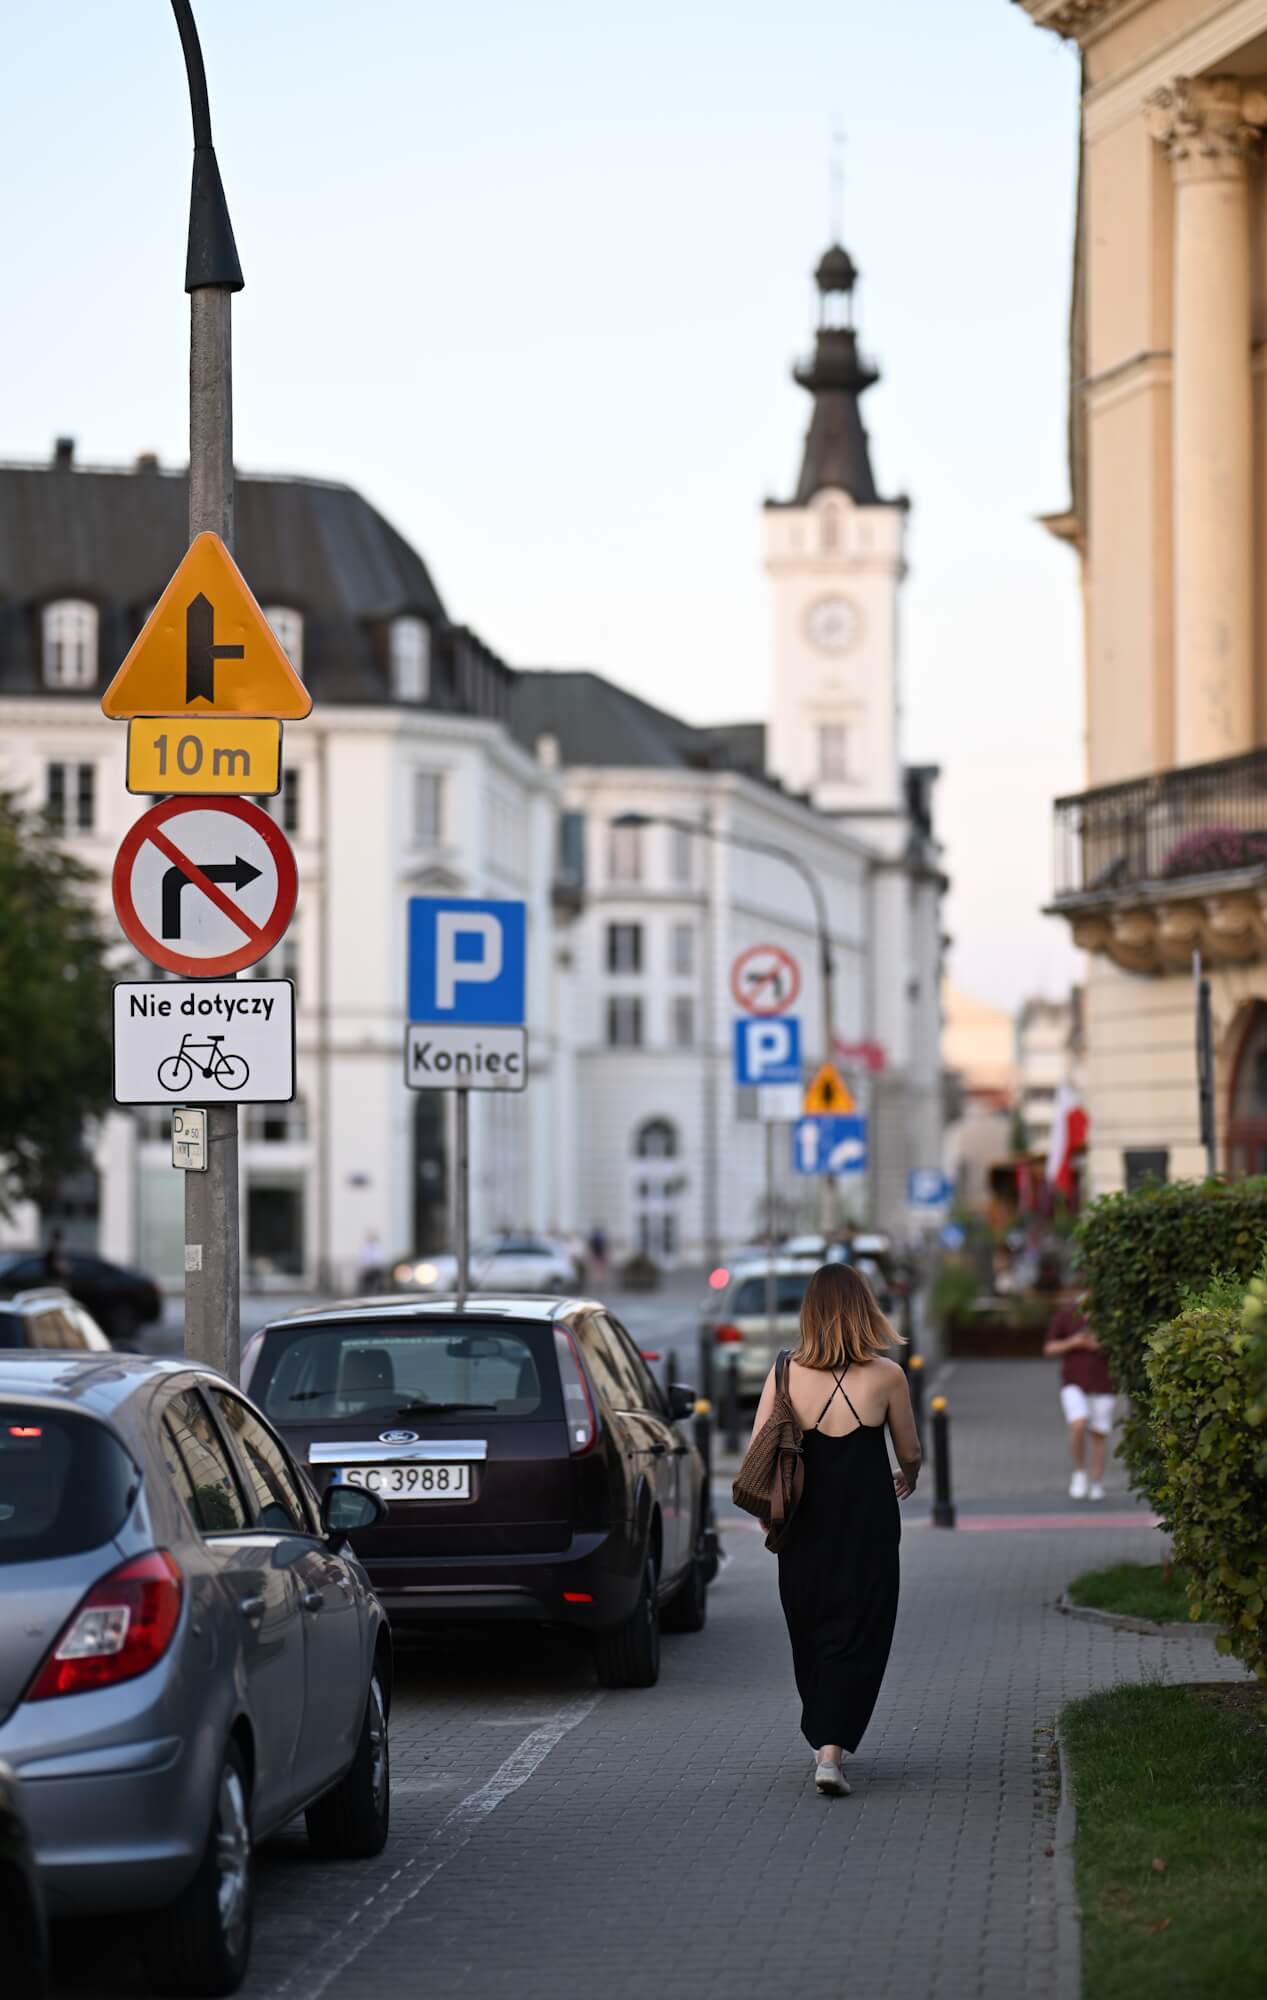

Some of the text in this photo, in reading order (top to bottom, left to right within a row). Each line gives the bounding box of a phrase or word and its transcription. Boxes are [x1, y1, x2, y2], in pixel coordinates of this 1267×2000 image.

[435, 911, 503, 1010] P
[130, 993, 274, 1022] Nie dotyczy
[413, 1042, 520, 1074] Koniec
[746, 1023, 790, 1078] P
[347, 1467, 464, 1491] SC 3988J
